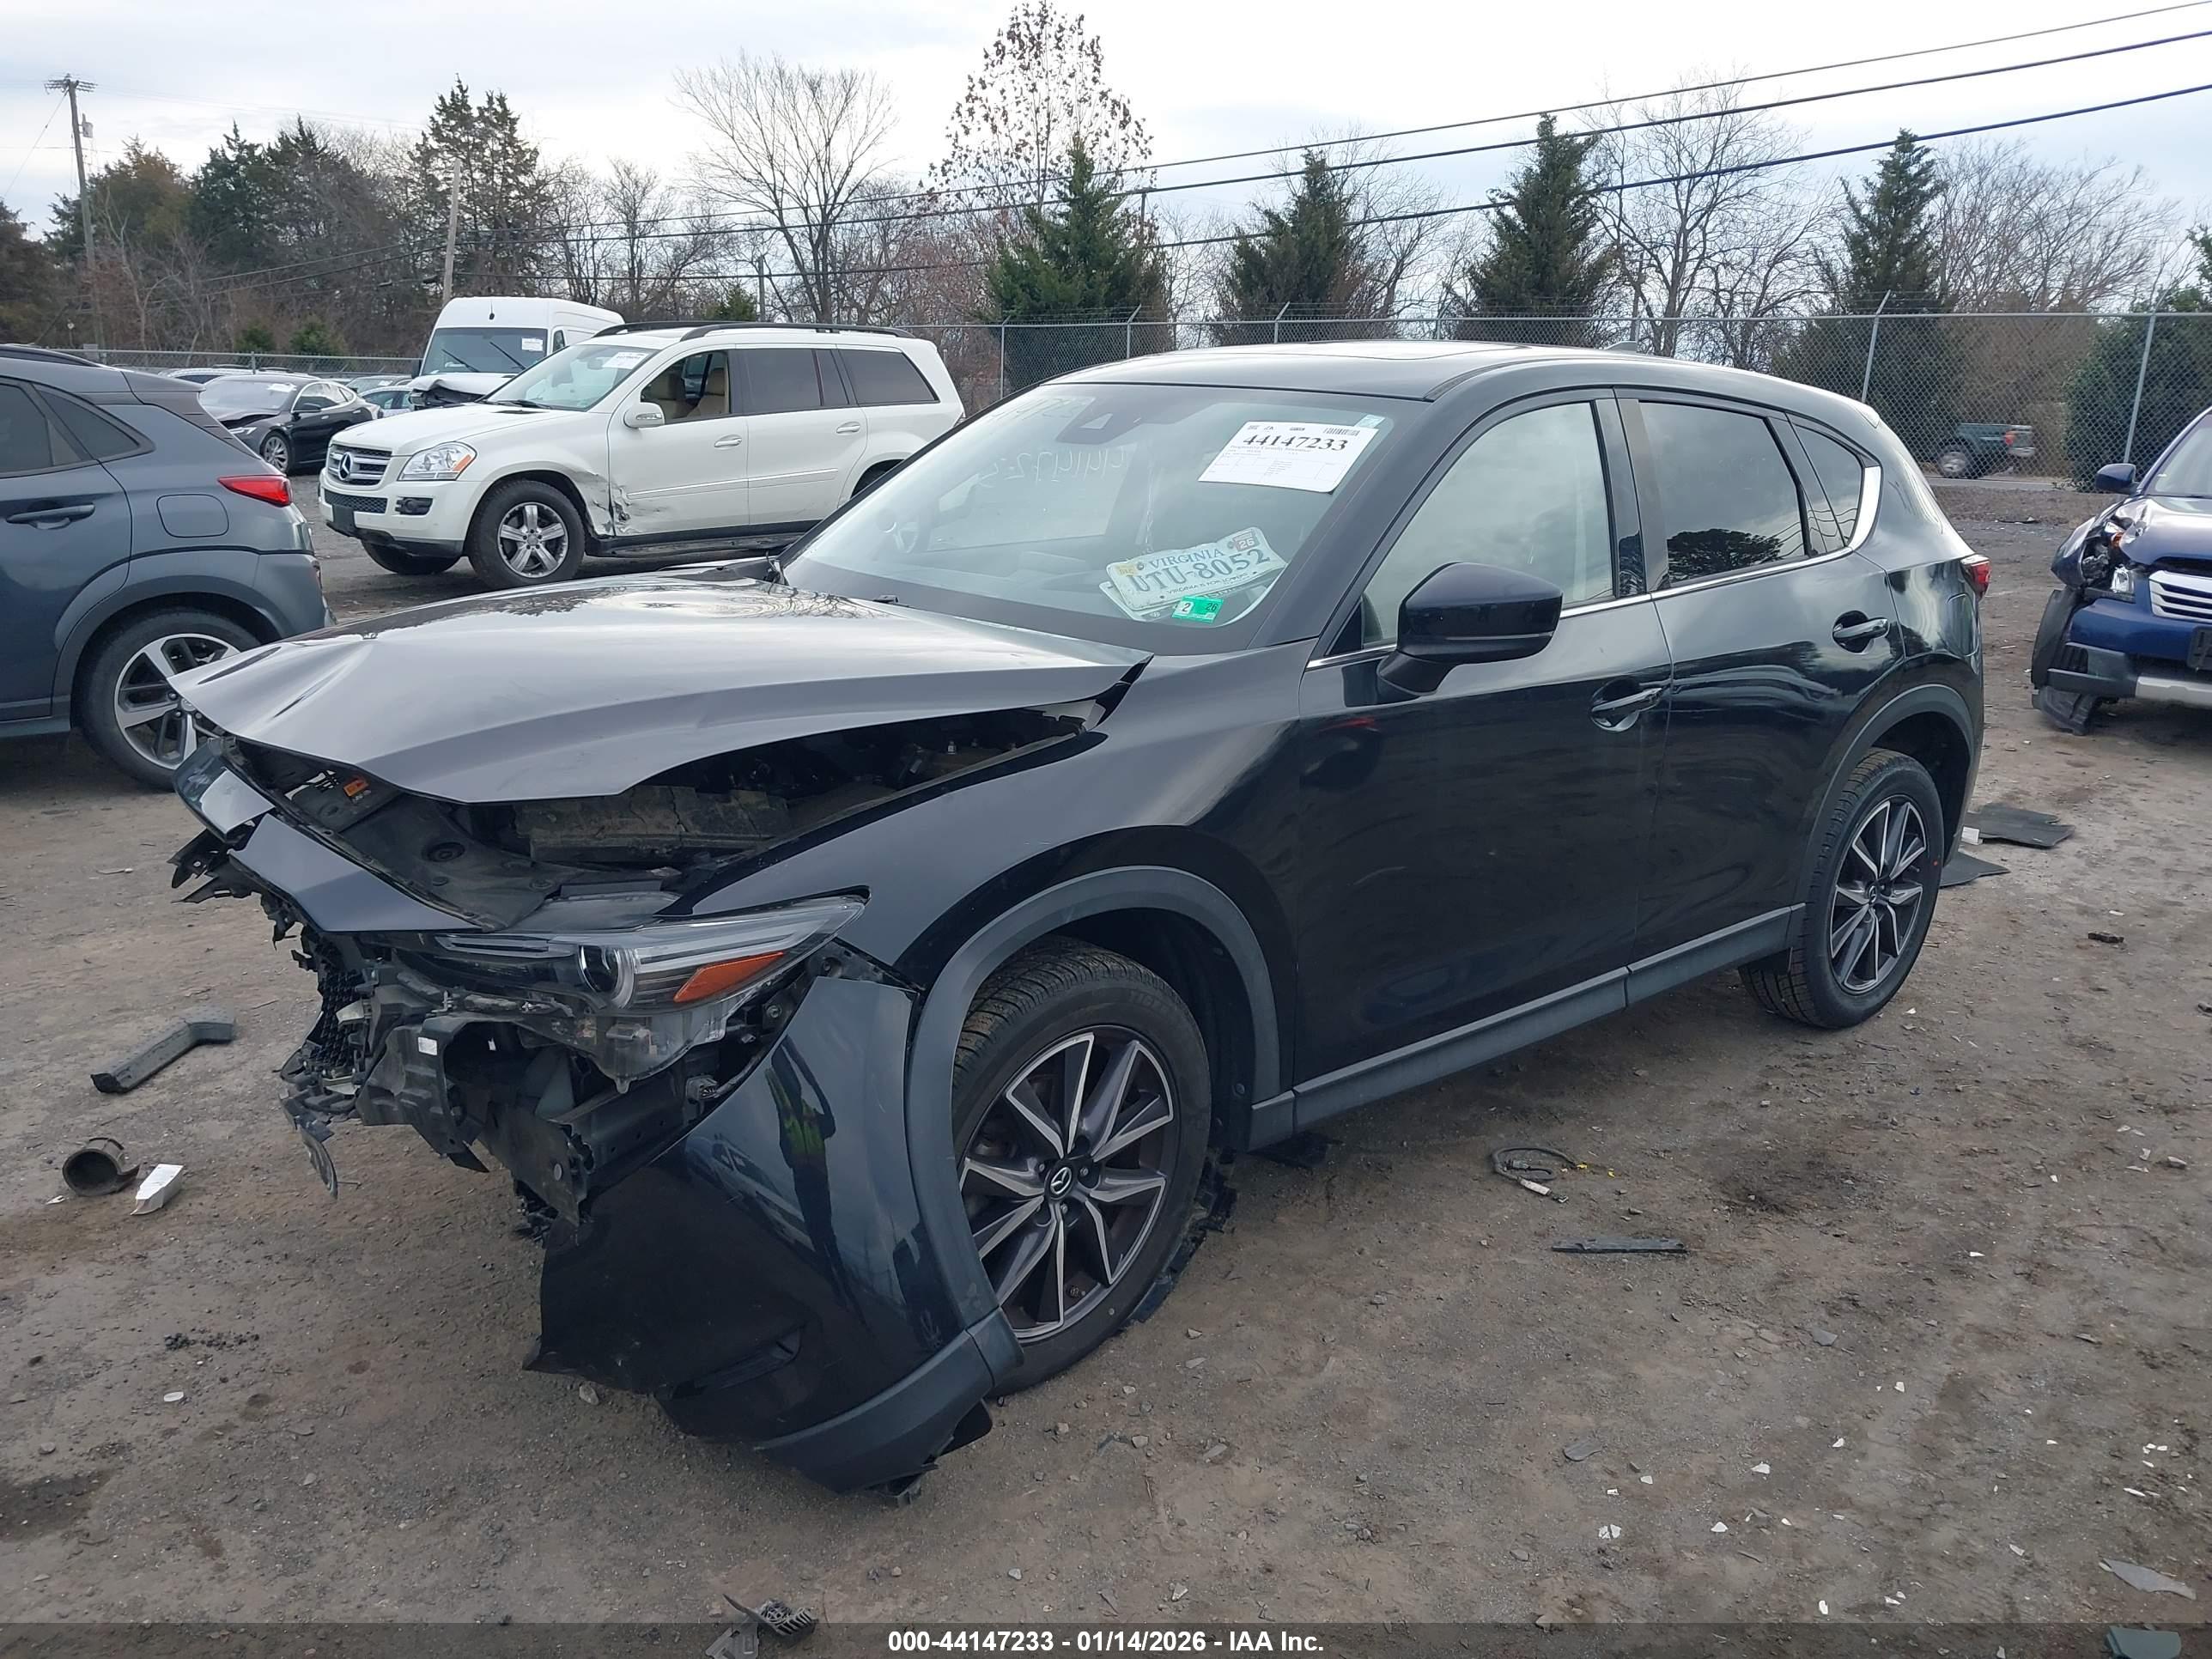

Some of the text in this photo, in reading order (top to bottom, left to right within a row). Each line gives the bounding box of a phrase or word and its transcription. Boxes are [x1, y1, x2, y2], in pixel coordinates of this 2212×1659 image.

[1243, 434, 1349, 452] 44147233
[1149, 549, 1224, 568] VIRGINIA
[1127, 549, 1270, 592] UTU-8052
[1182, 603, 1218, 612] 2 26
